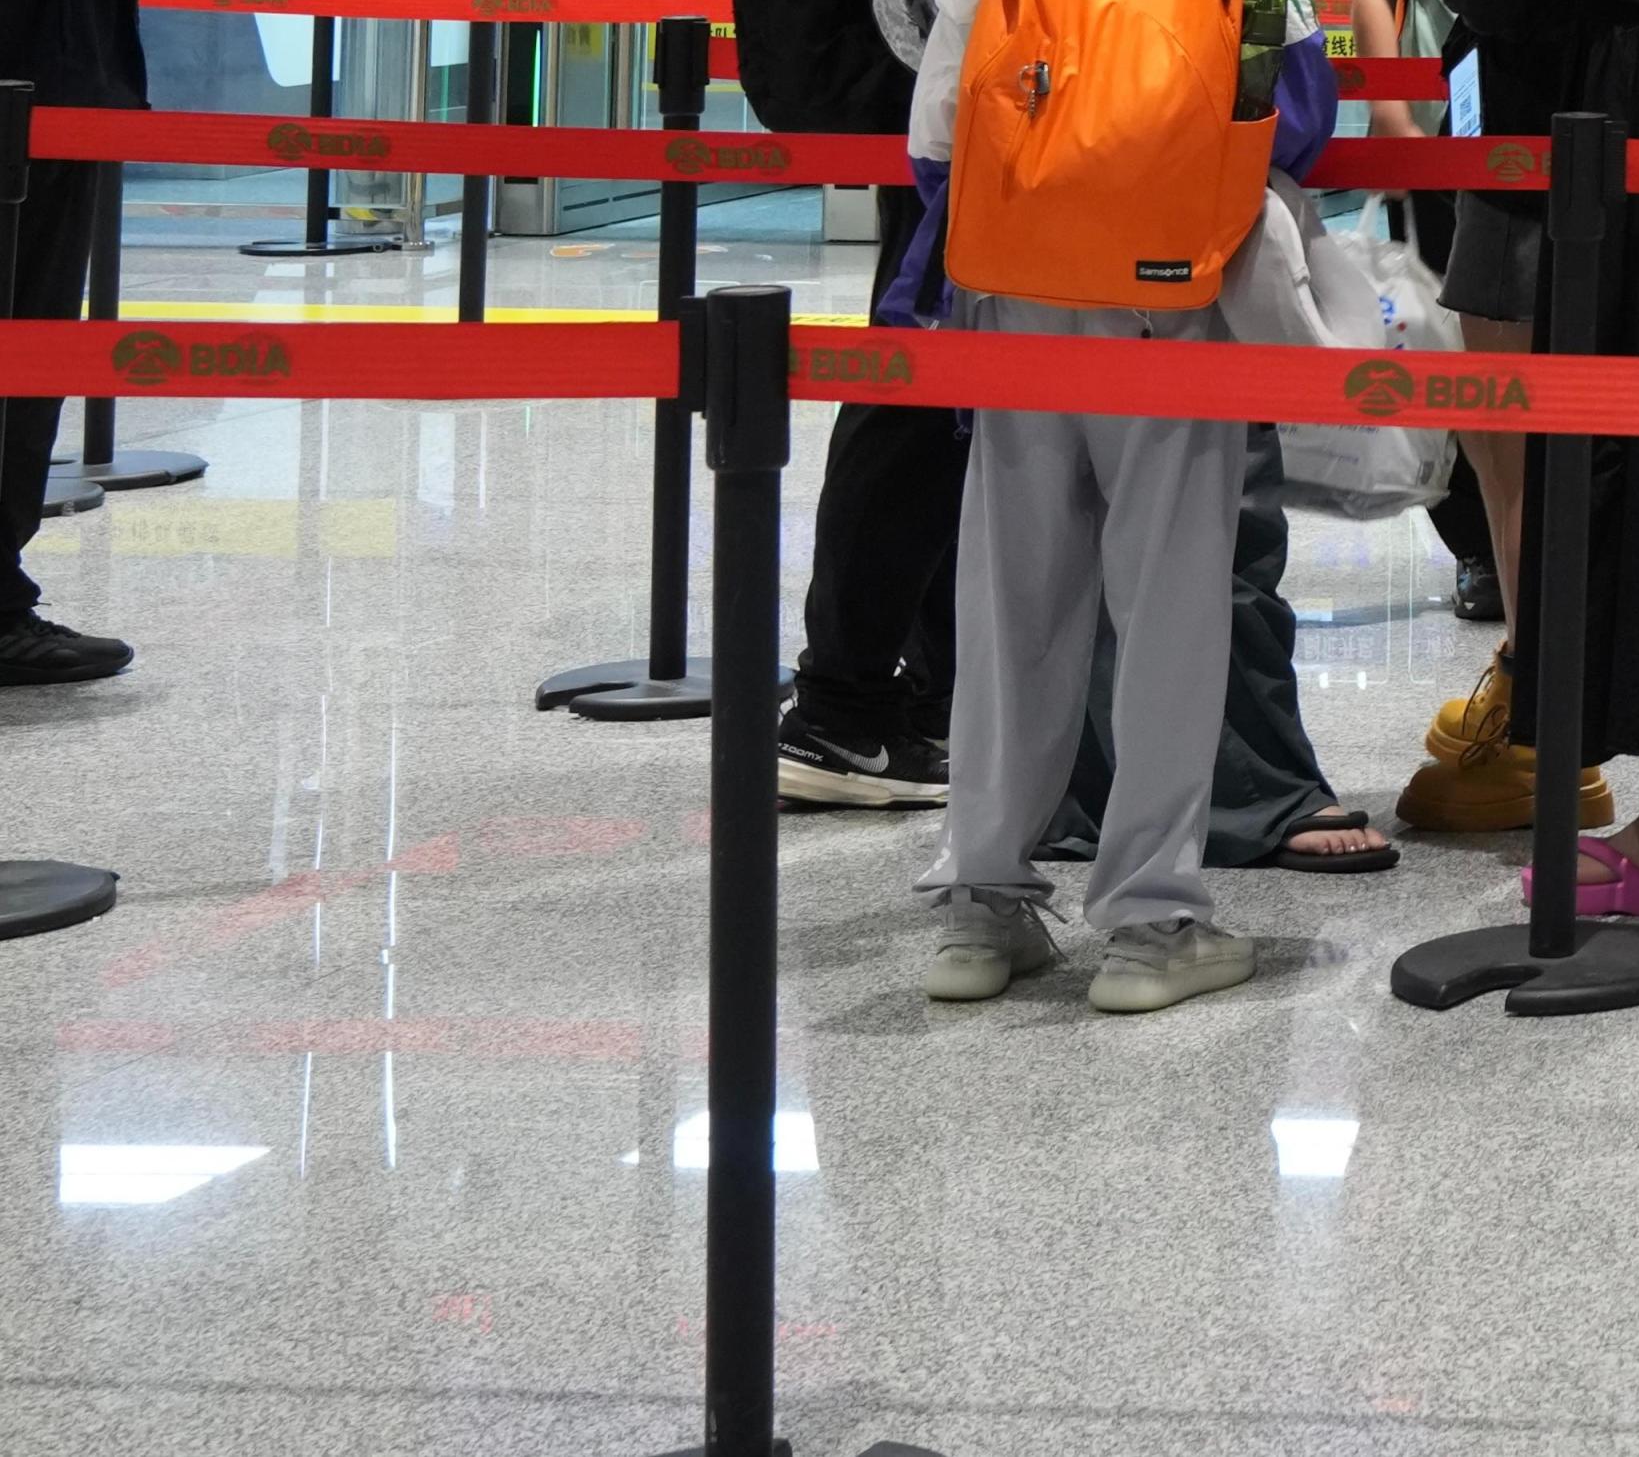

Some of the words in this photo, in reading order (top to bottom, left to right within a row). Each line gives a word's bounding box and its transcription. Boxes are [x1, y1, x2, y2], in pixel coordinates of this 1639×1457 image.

[319, 134, 389, 157] BDIA
[717, 147, 789, 171] BDIA
[189, 342, 292, 378] BDIA
[809, 347, 914, 386] BDIA
[1424, 373, 1532, 412] BDIA
